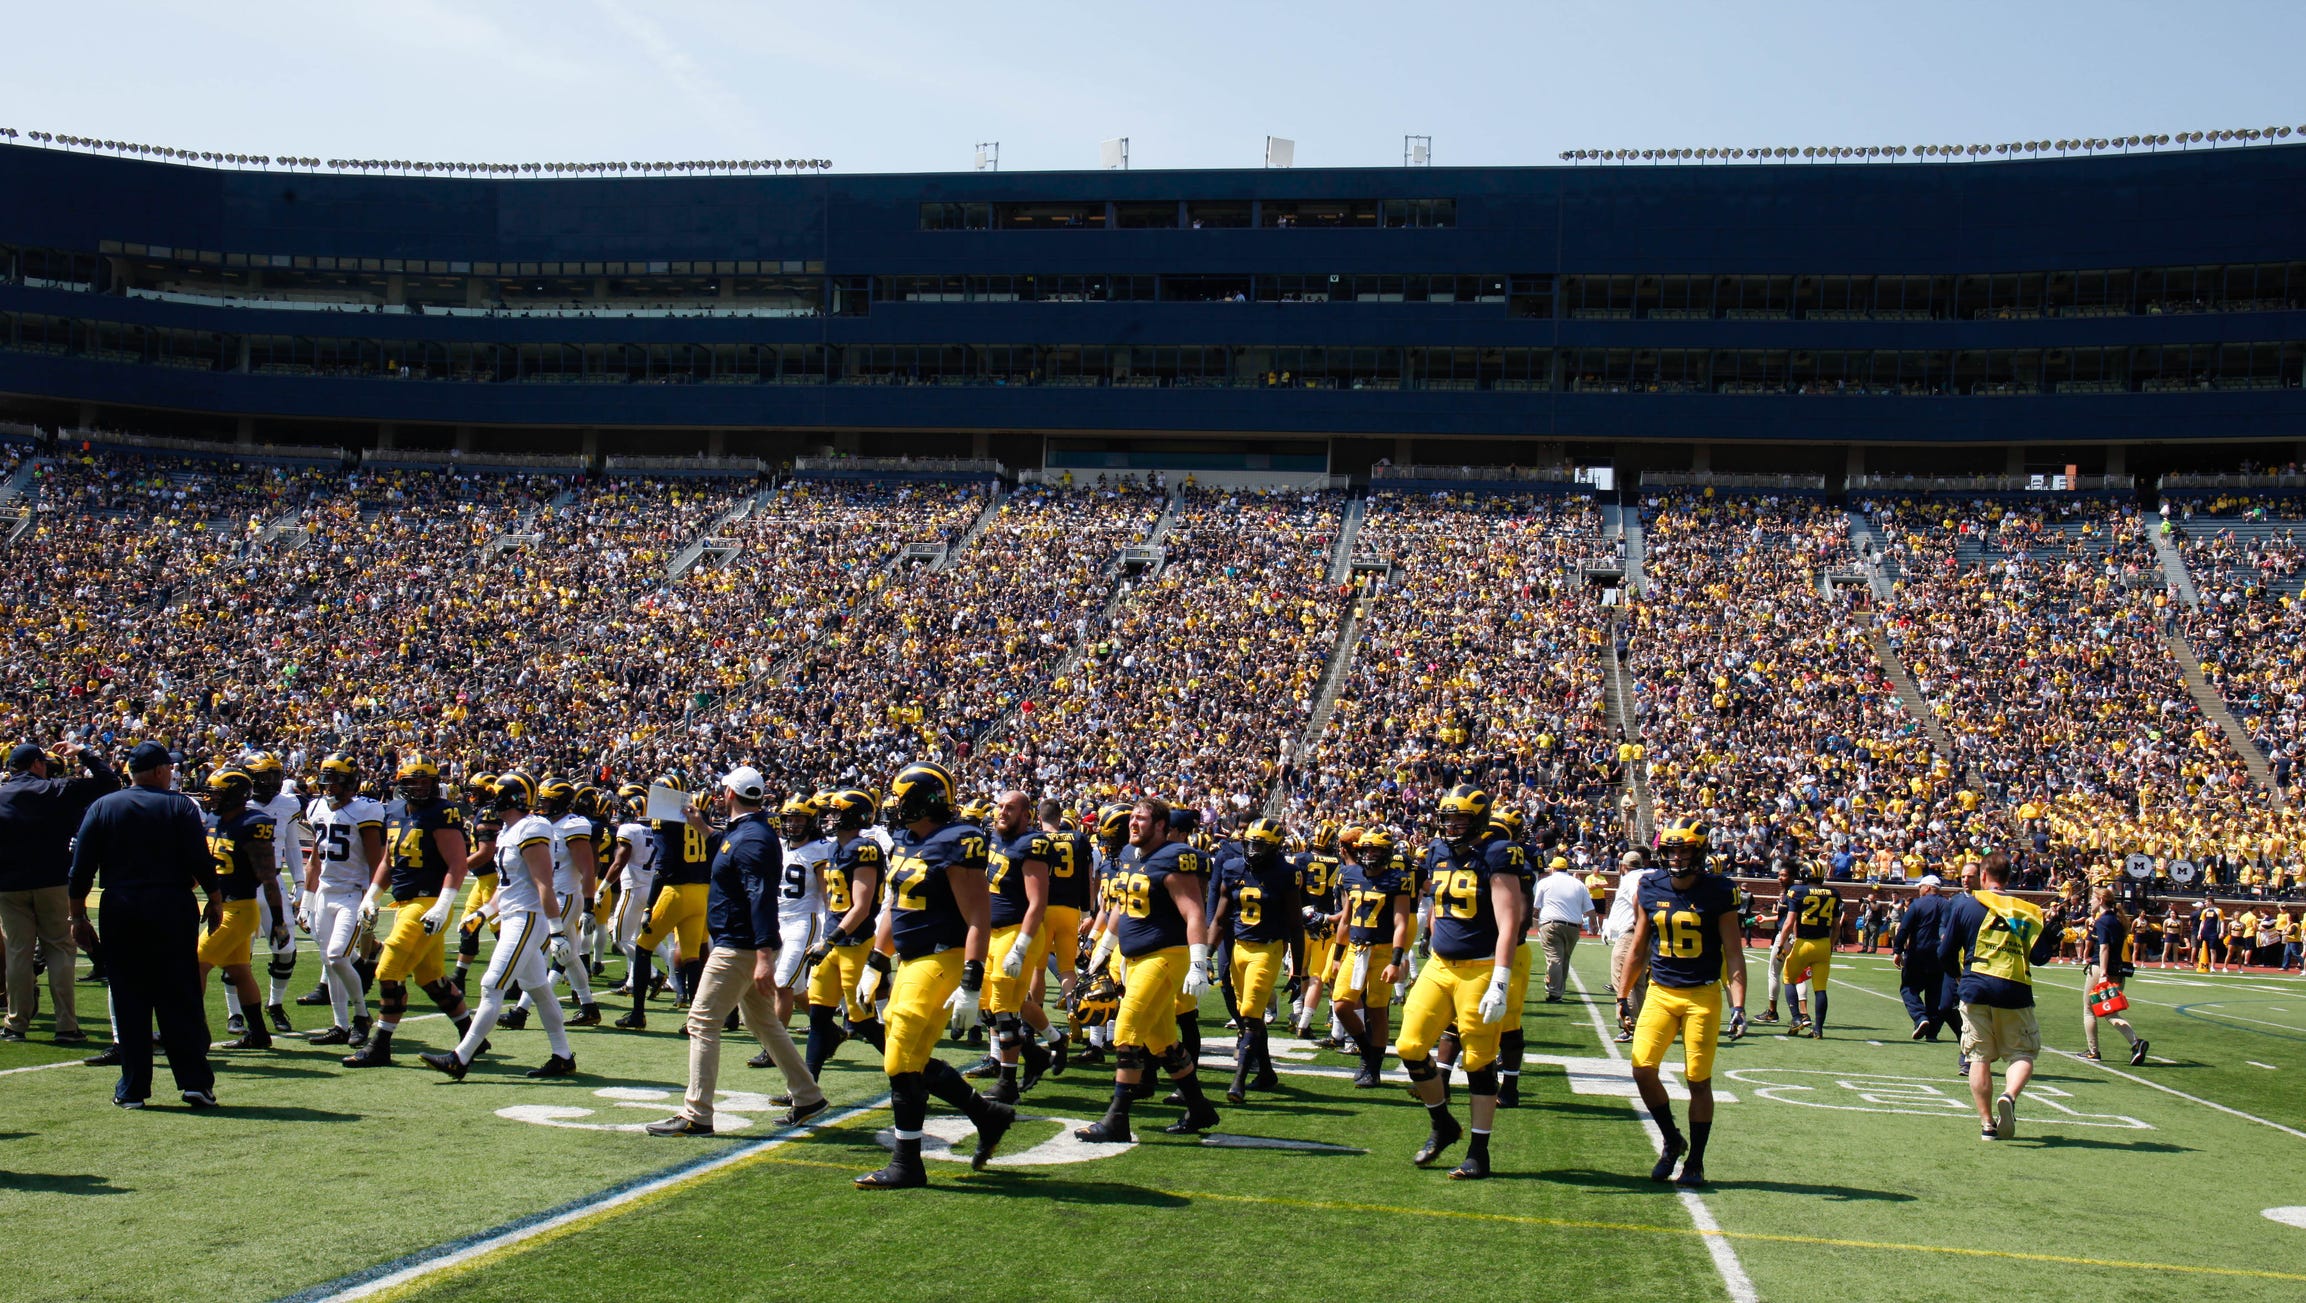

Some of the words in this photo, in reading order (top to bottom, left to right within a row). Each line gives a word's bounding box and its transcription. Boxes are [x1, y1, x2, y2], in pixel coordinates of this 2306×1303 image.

[443, 807, 461, 824] 74
[254, 823, 273, 839] 35
[386, 827, 424, 868] 74
[857, 845, 878, 862] 28
[960, 836, 986, 859] 72
[1031, 838, 1050, 855] 57
[1506, 846, 1525, 865] 79
[1053, 841, 1075, 878] 3
[1178, 853, 1198, 871] 68
[2133, 861, 2145, 870] M
[778, 863, 806, 899] 9
[2177, 867, 2188, 875] M
[885, 855, 929, 911] 72
[1401, 877, 1413, 892] 27
[1431, 870, 1478, 919] 79
[1239, 886, 1263, 926] 6
[1348, 890, 1387, 928] 27
[1800, 895, 1837, 927] 24
[1652, 910, 1703, 959] 16
[2102, 1001, 2112, 1012] G
